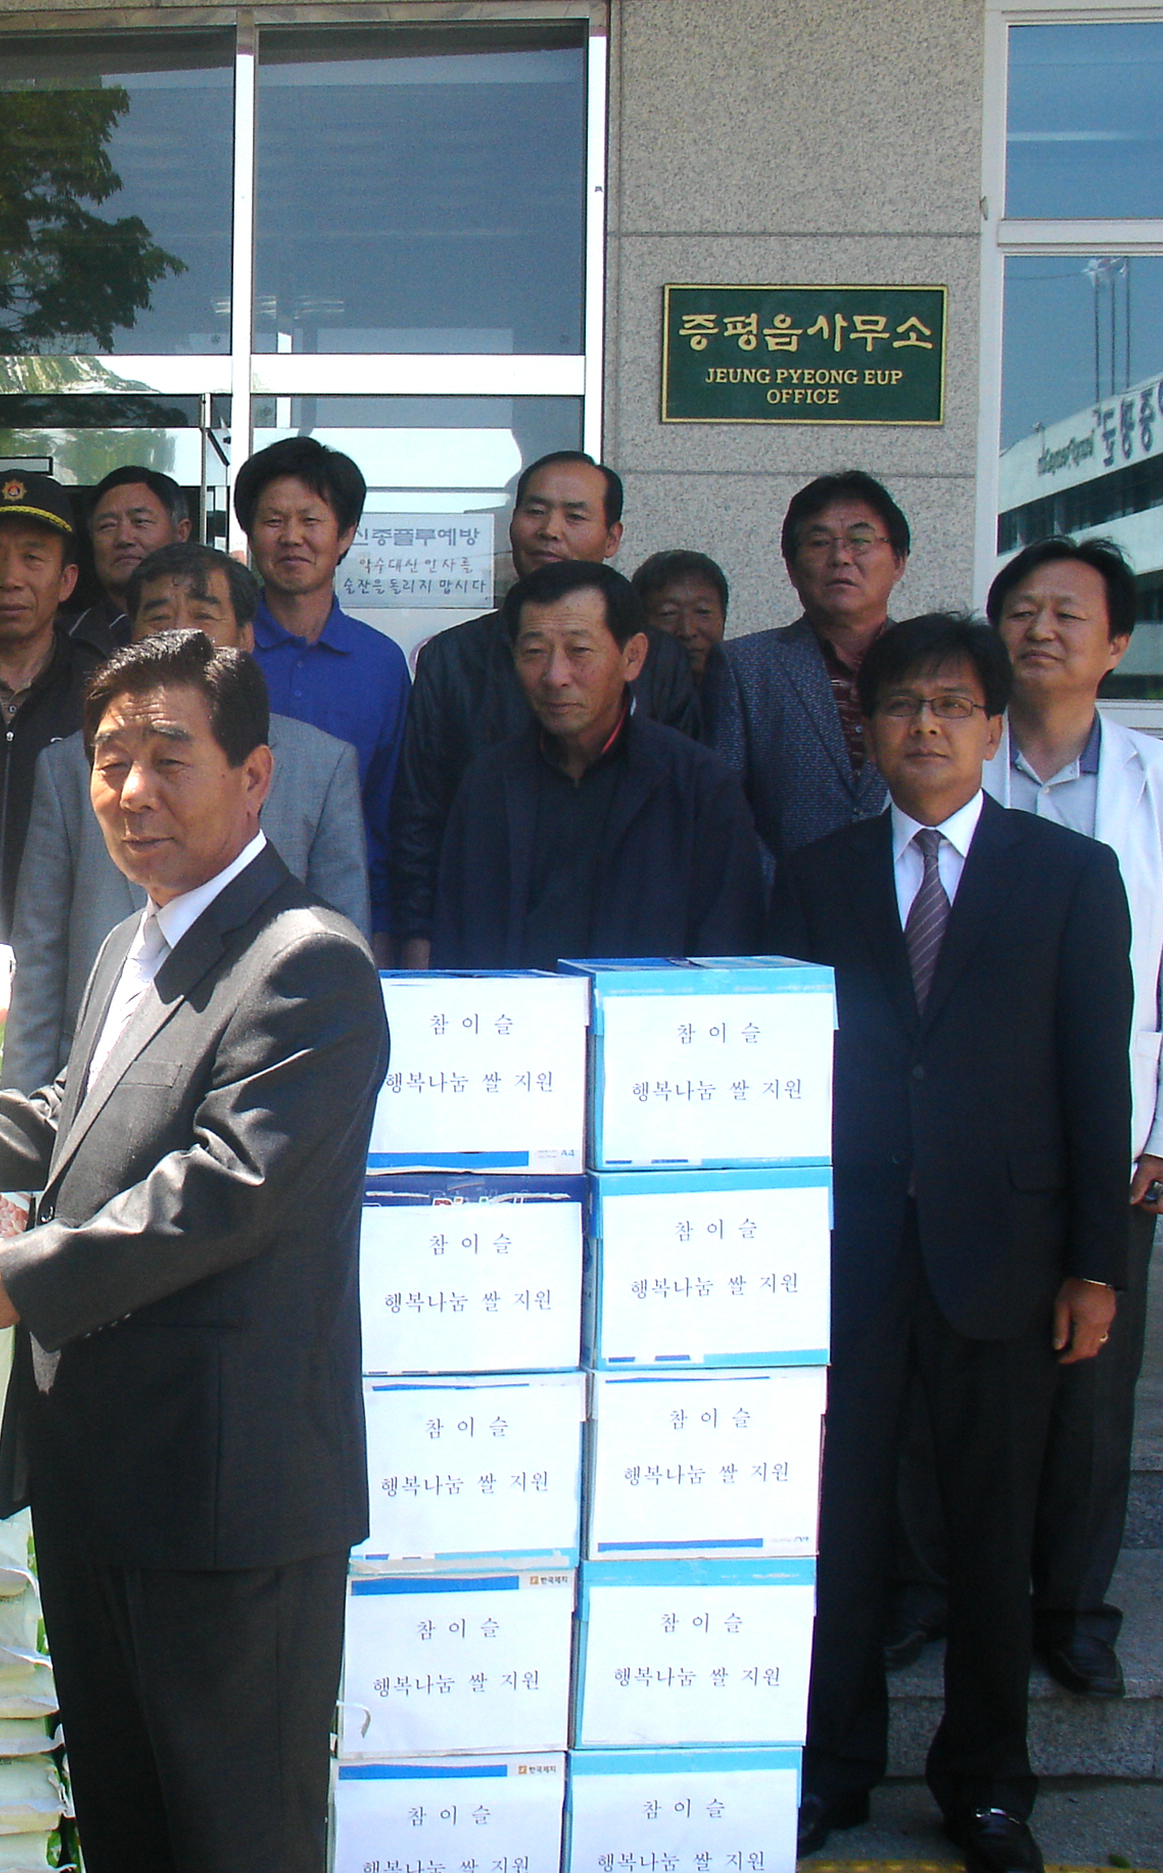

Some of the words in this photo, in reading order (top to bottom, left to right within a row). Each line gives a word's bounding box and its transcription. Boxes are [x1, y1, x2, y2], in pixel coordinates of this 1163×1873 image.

[679, 313, 934, 353] 증평읍사무소
[705, 368, 771, 385] JEUNG
[776, 369, 858, 386] PYEONG
[864, 370, 903, 386] EUP
[767, 388, 839, 405] OFFICE
[359, 558, 418, 574] 악수대신
[344, 578, 386, 595] 술잔을
[390, 579, 431, 595] 돌리지
[439, 579, 487, 595] 맙시다
[385, 1071, 469, 1095] 행복나눔
[482, 1071, 502, 1094] 쌀
[515, 1070, 553, 1093] 지원
[632, 1079, 717, 1103] 행복나눔
[729, 1079, 751, 1101] 쌀
[762, 1078, 802, 1100] 지원
[631, 1276, 714, 1300] 행복나눔
[727, 1274, 747, 1296] 쌀
[760, 1272, 799, 1294] 지원
[384, 1291, 469, 1315] 행복나눔
[482, 1290, 502, 1313] 쌀
[514, 1289, 552, 1312] 지원
[381, 1474, 464, 1498] 행복나눔
[477, 1472, 497, 1495] 쌀
[510, 1470, 548, 1493] 지원
[624, 1463, 706, 1488] 행복나눔
[719, 1462, 739, 1485] 쌀
[752, 1461, 789, 1483] 지원
[372, 1674, 456, 1699] 행복나눔
[468, 1672, 488, 1694] 쌀
[501, 1669, 539, 1692] 지원
[614, 1666, 697, 1688] 행복나눔
[711, 1666, 730, 1687] 쌀
[743, 1666, 780, 1687] 지원
[597, 1851, 680, 1873] 행복나눔
[693, 1851, 713, 1873] 쌀
[726, 1850, 765, 1872] 지원
